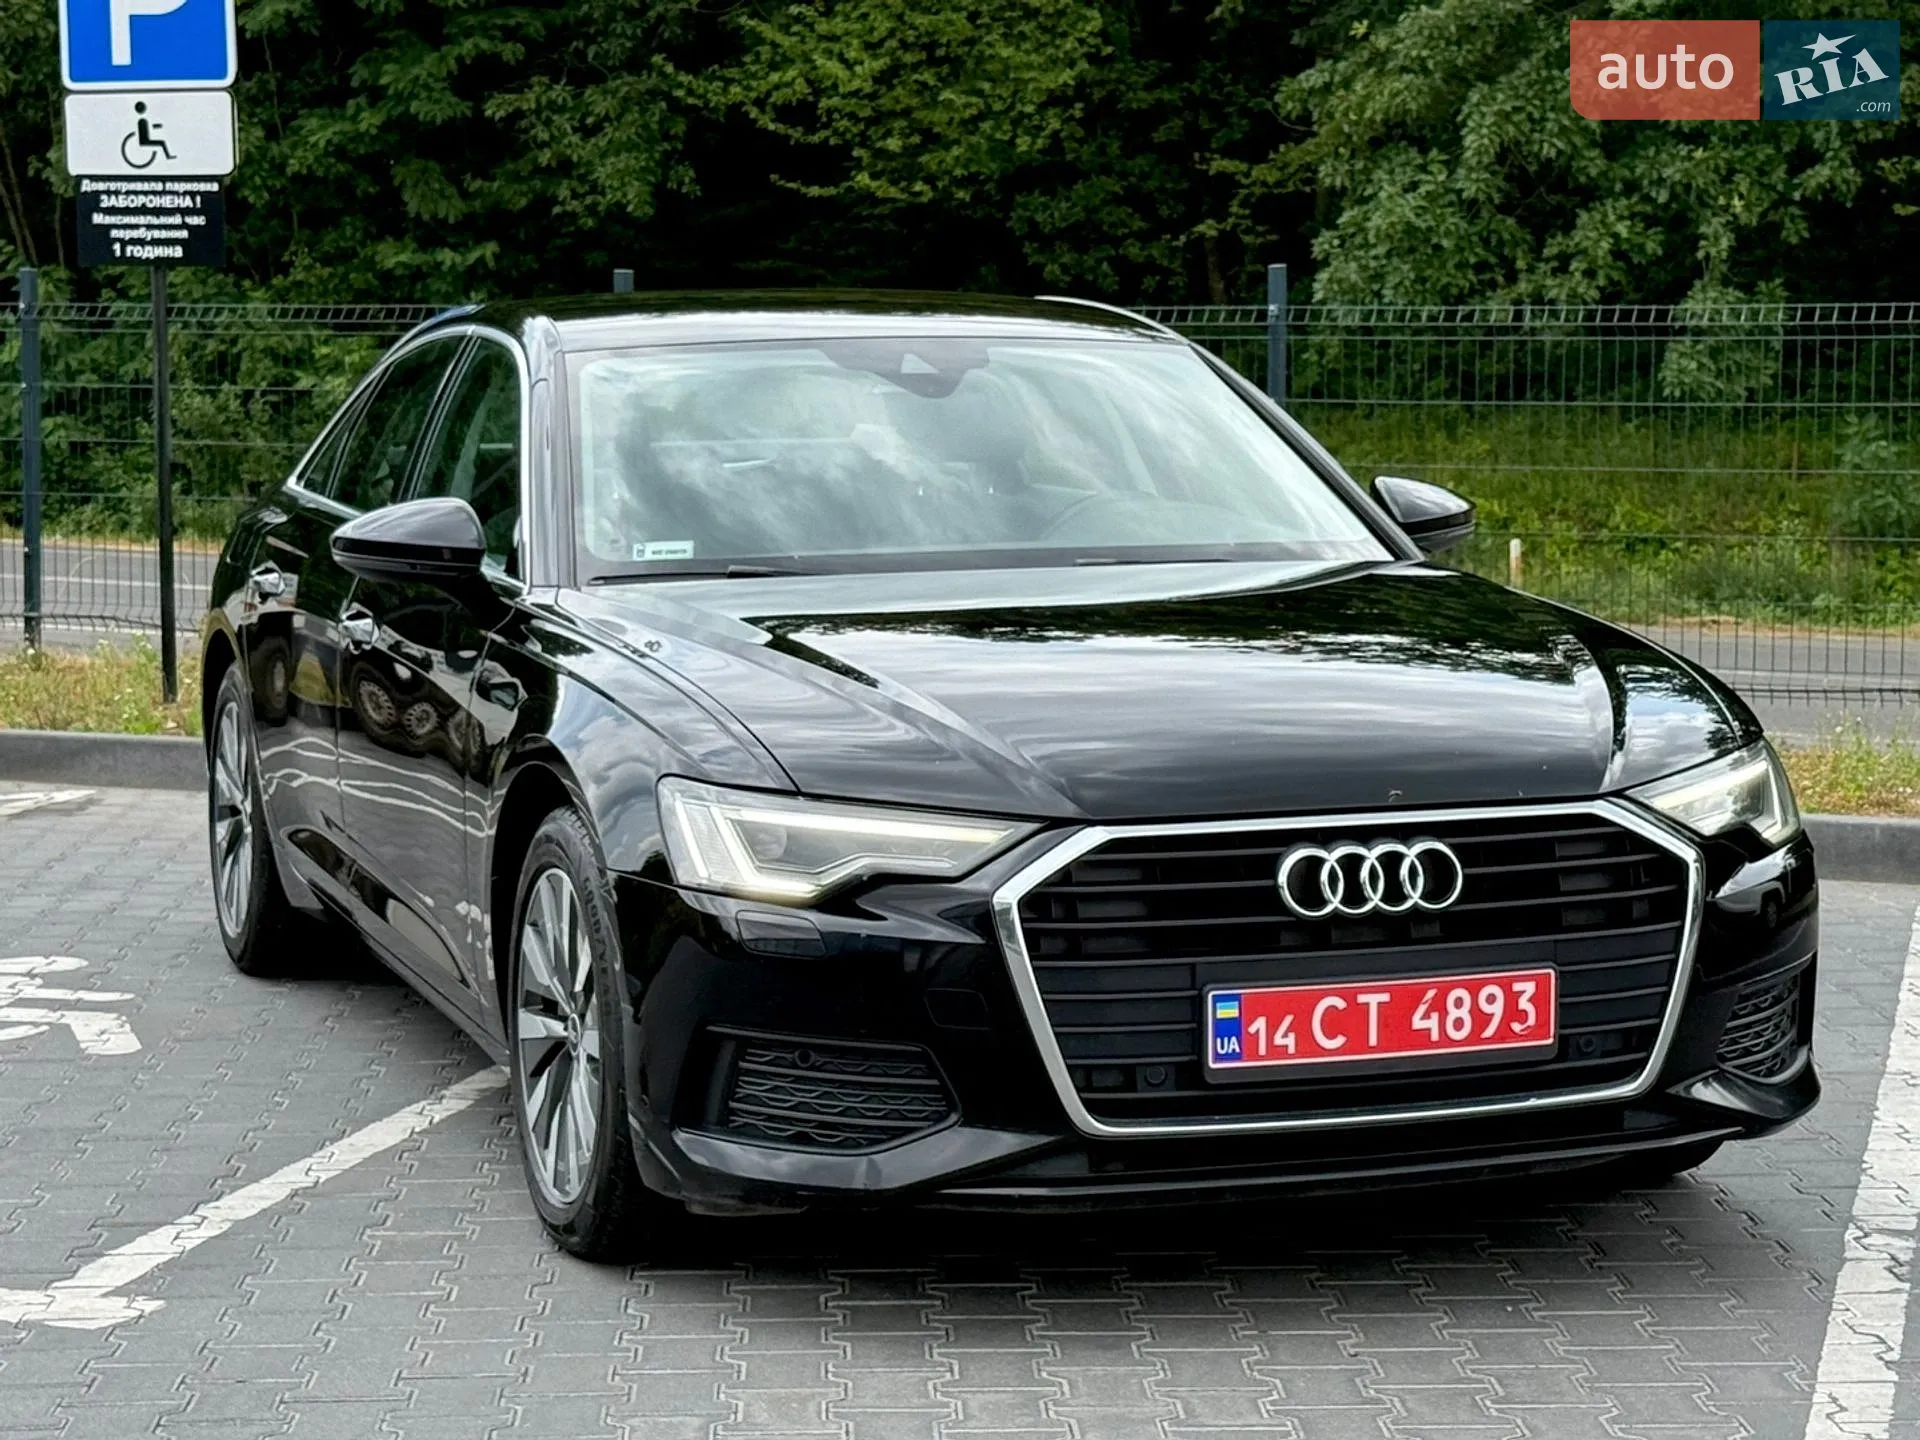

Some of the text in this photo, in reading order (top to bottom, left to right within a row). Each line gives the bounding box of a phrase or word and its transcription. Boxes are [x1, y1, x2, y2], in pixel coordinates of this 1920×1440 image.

[165, 181, 219, 193] парковка
[99, 195, 193, 208] ЗАБОРОНЕНА
[92, 212, 206, 225] Максимальний час
[110, 227, 189, 240] перебування
[112, 243, 183, 259] 1 година
[1248, 1015, 1296, 1056] 14
[1411, 981, 1537, 1042] 4893
[1216, 1037, 1240, 1054] UA
